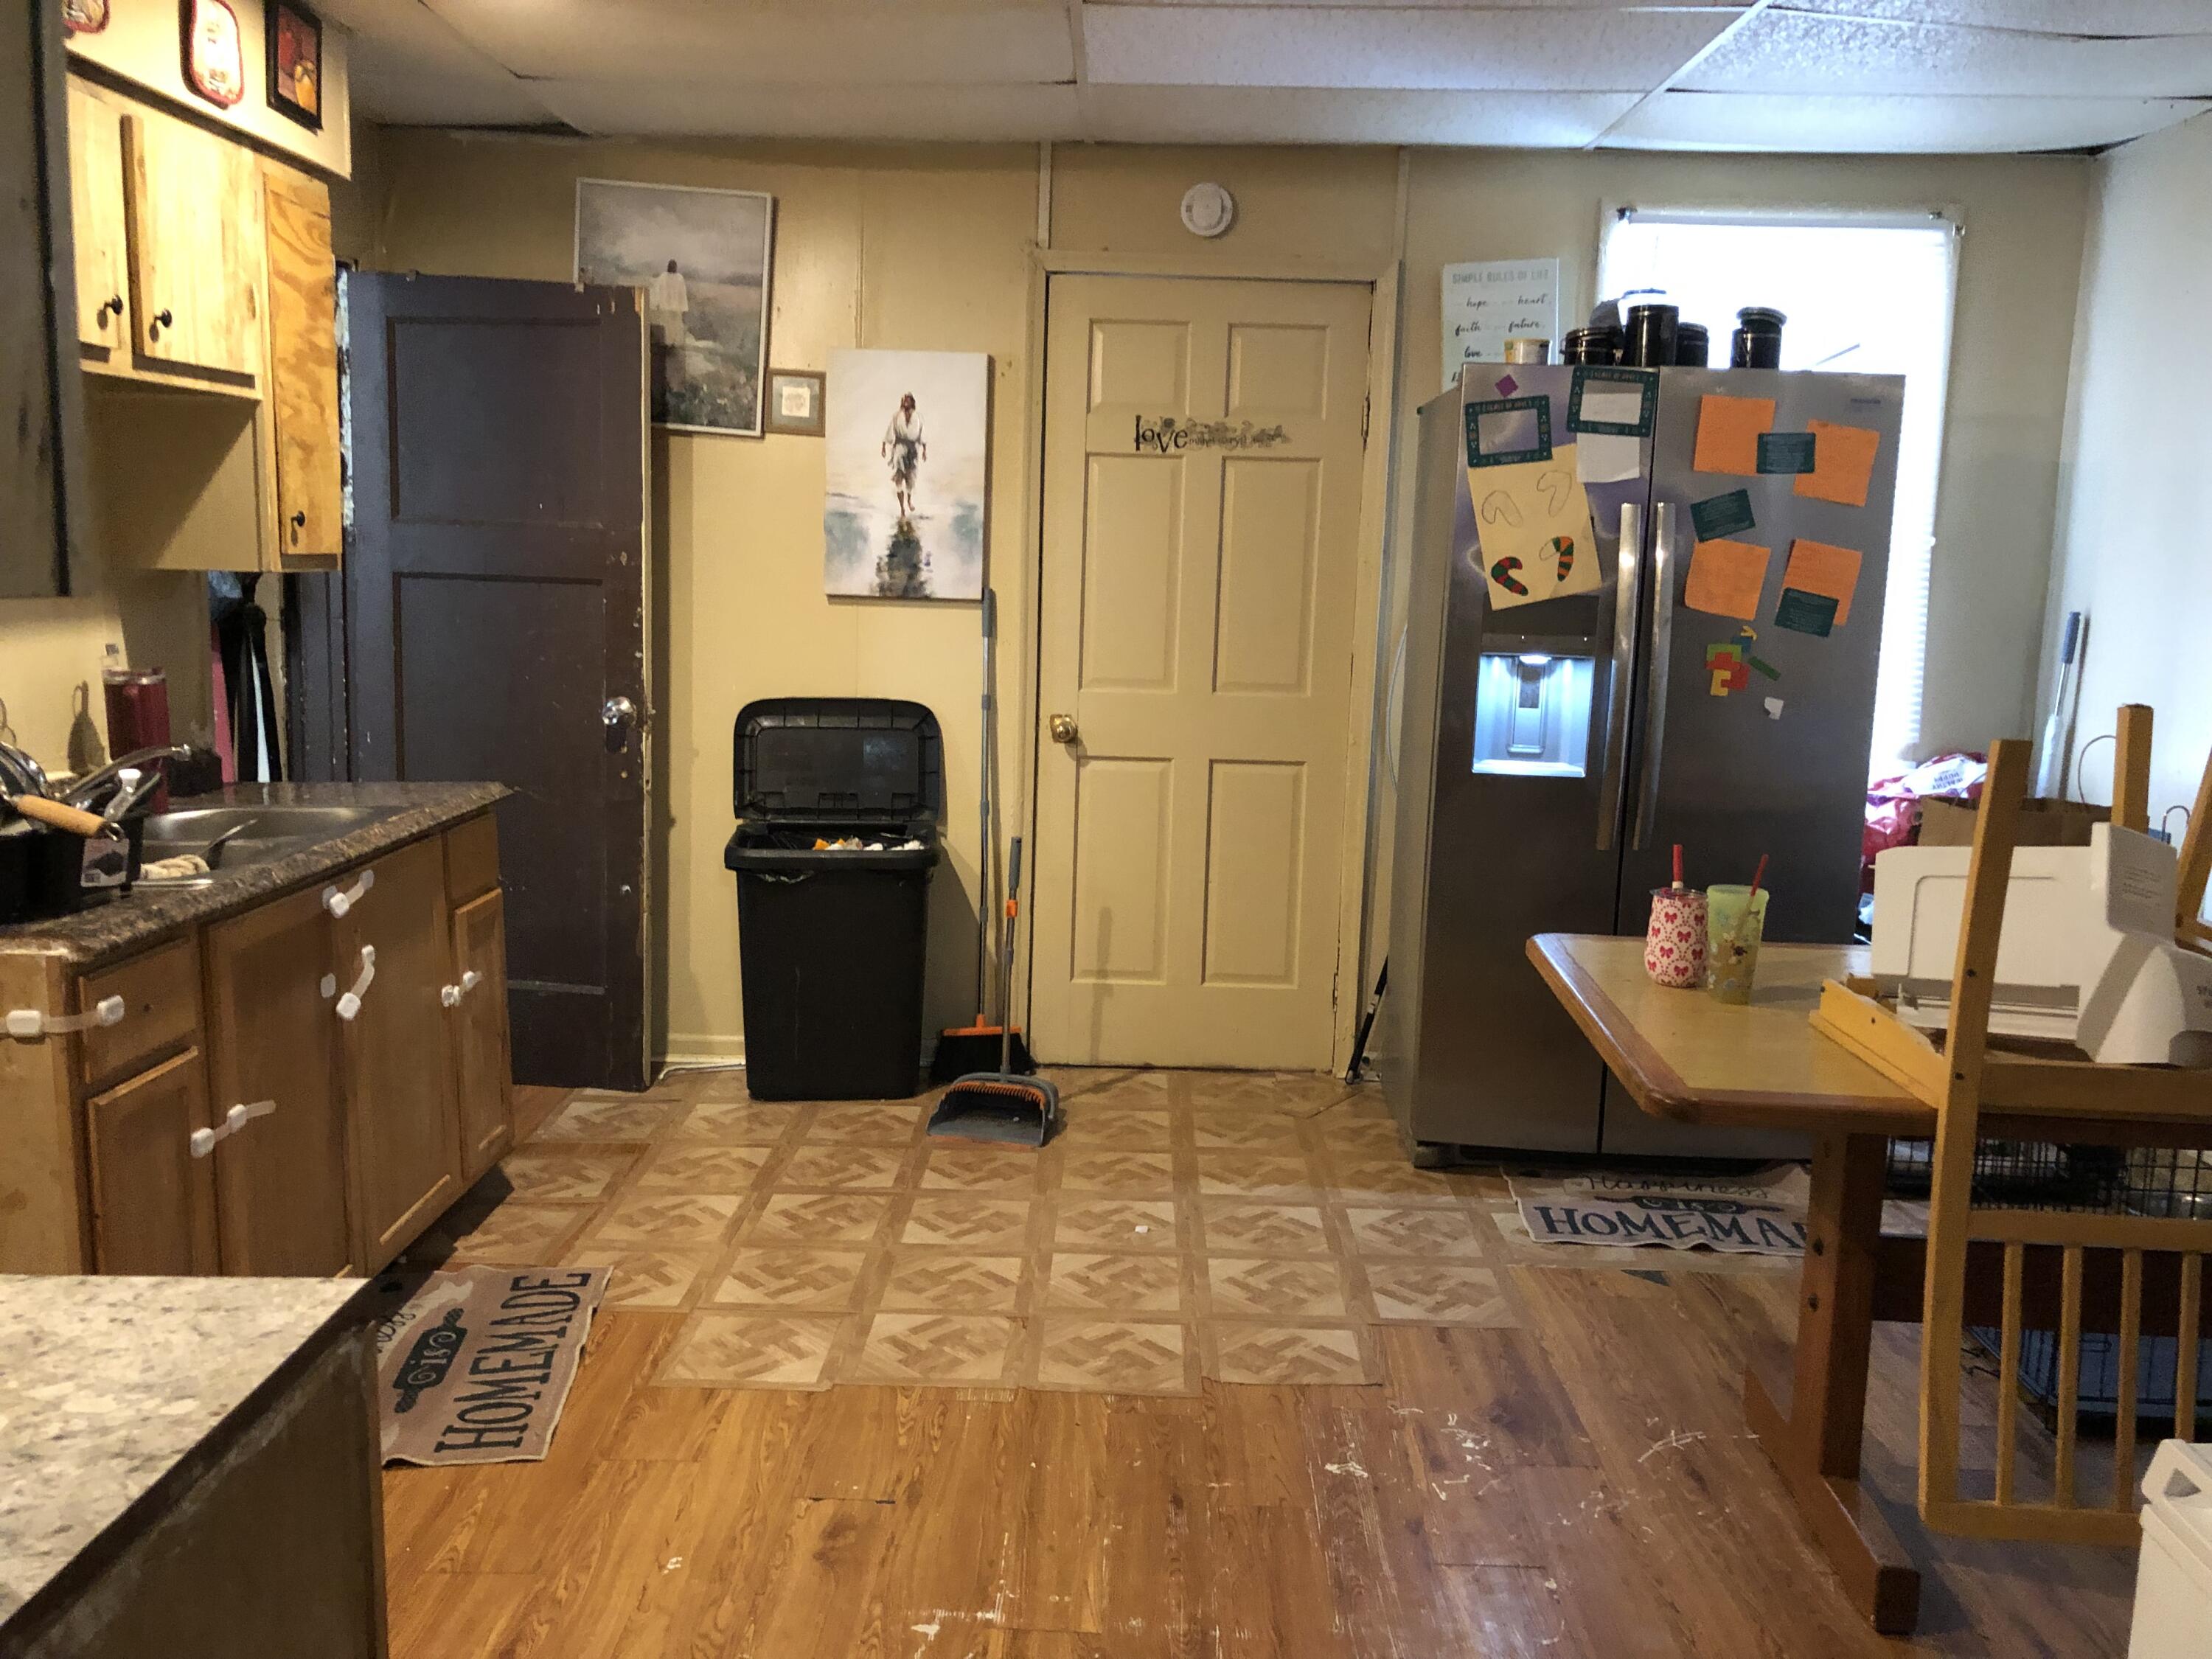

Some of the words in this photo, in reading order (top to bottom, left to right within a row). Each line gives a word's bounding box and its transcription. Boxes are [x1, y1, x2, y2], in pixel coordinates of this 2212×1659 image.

[1486, 270, 1514, 282] RULES
[1517, 270, 1528, 281] OF
[1466, 296, 1487, 310] hope
[1455, 321, 1481, 336] faith
[1135, 414, 1189, 453] love
[434, 1273, 592, 1453] HOMEMADE
